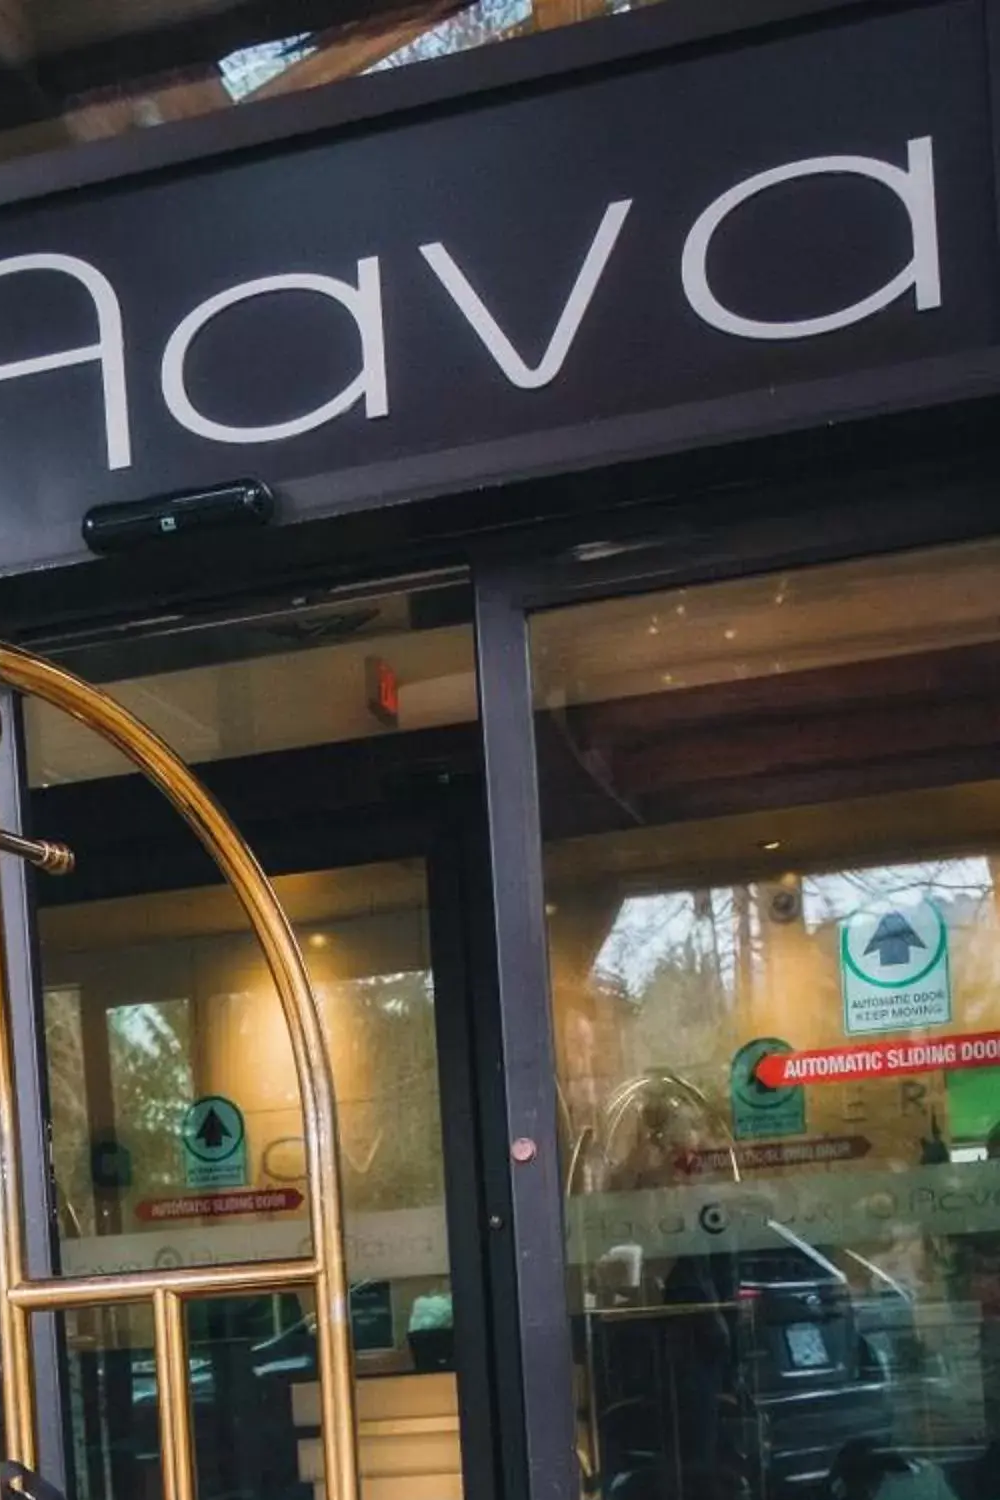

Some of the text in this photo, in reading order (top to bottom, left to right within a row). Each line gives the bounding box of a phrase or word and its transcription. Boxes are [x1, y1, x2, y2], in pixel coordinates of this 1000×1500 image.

[851, 993, 910, 1008] AUTOMATIC
[784, 1051, 883, 1079] AUTOMATIC
[887, 1043, 956, 1068] SLIDING
